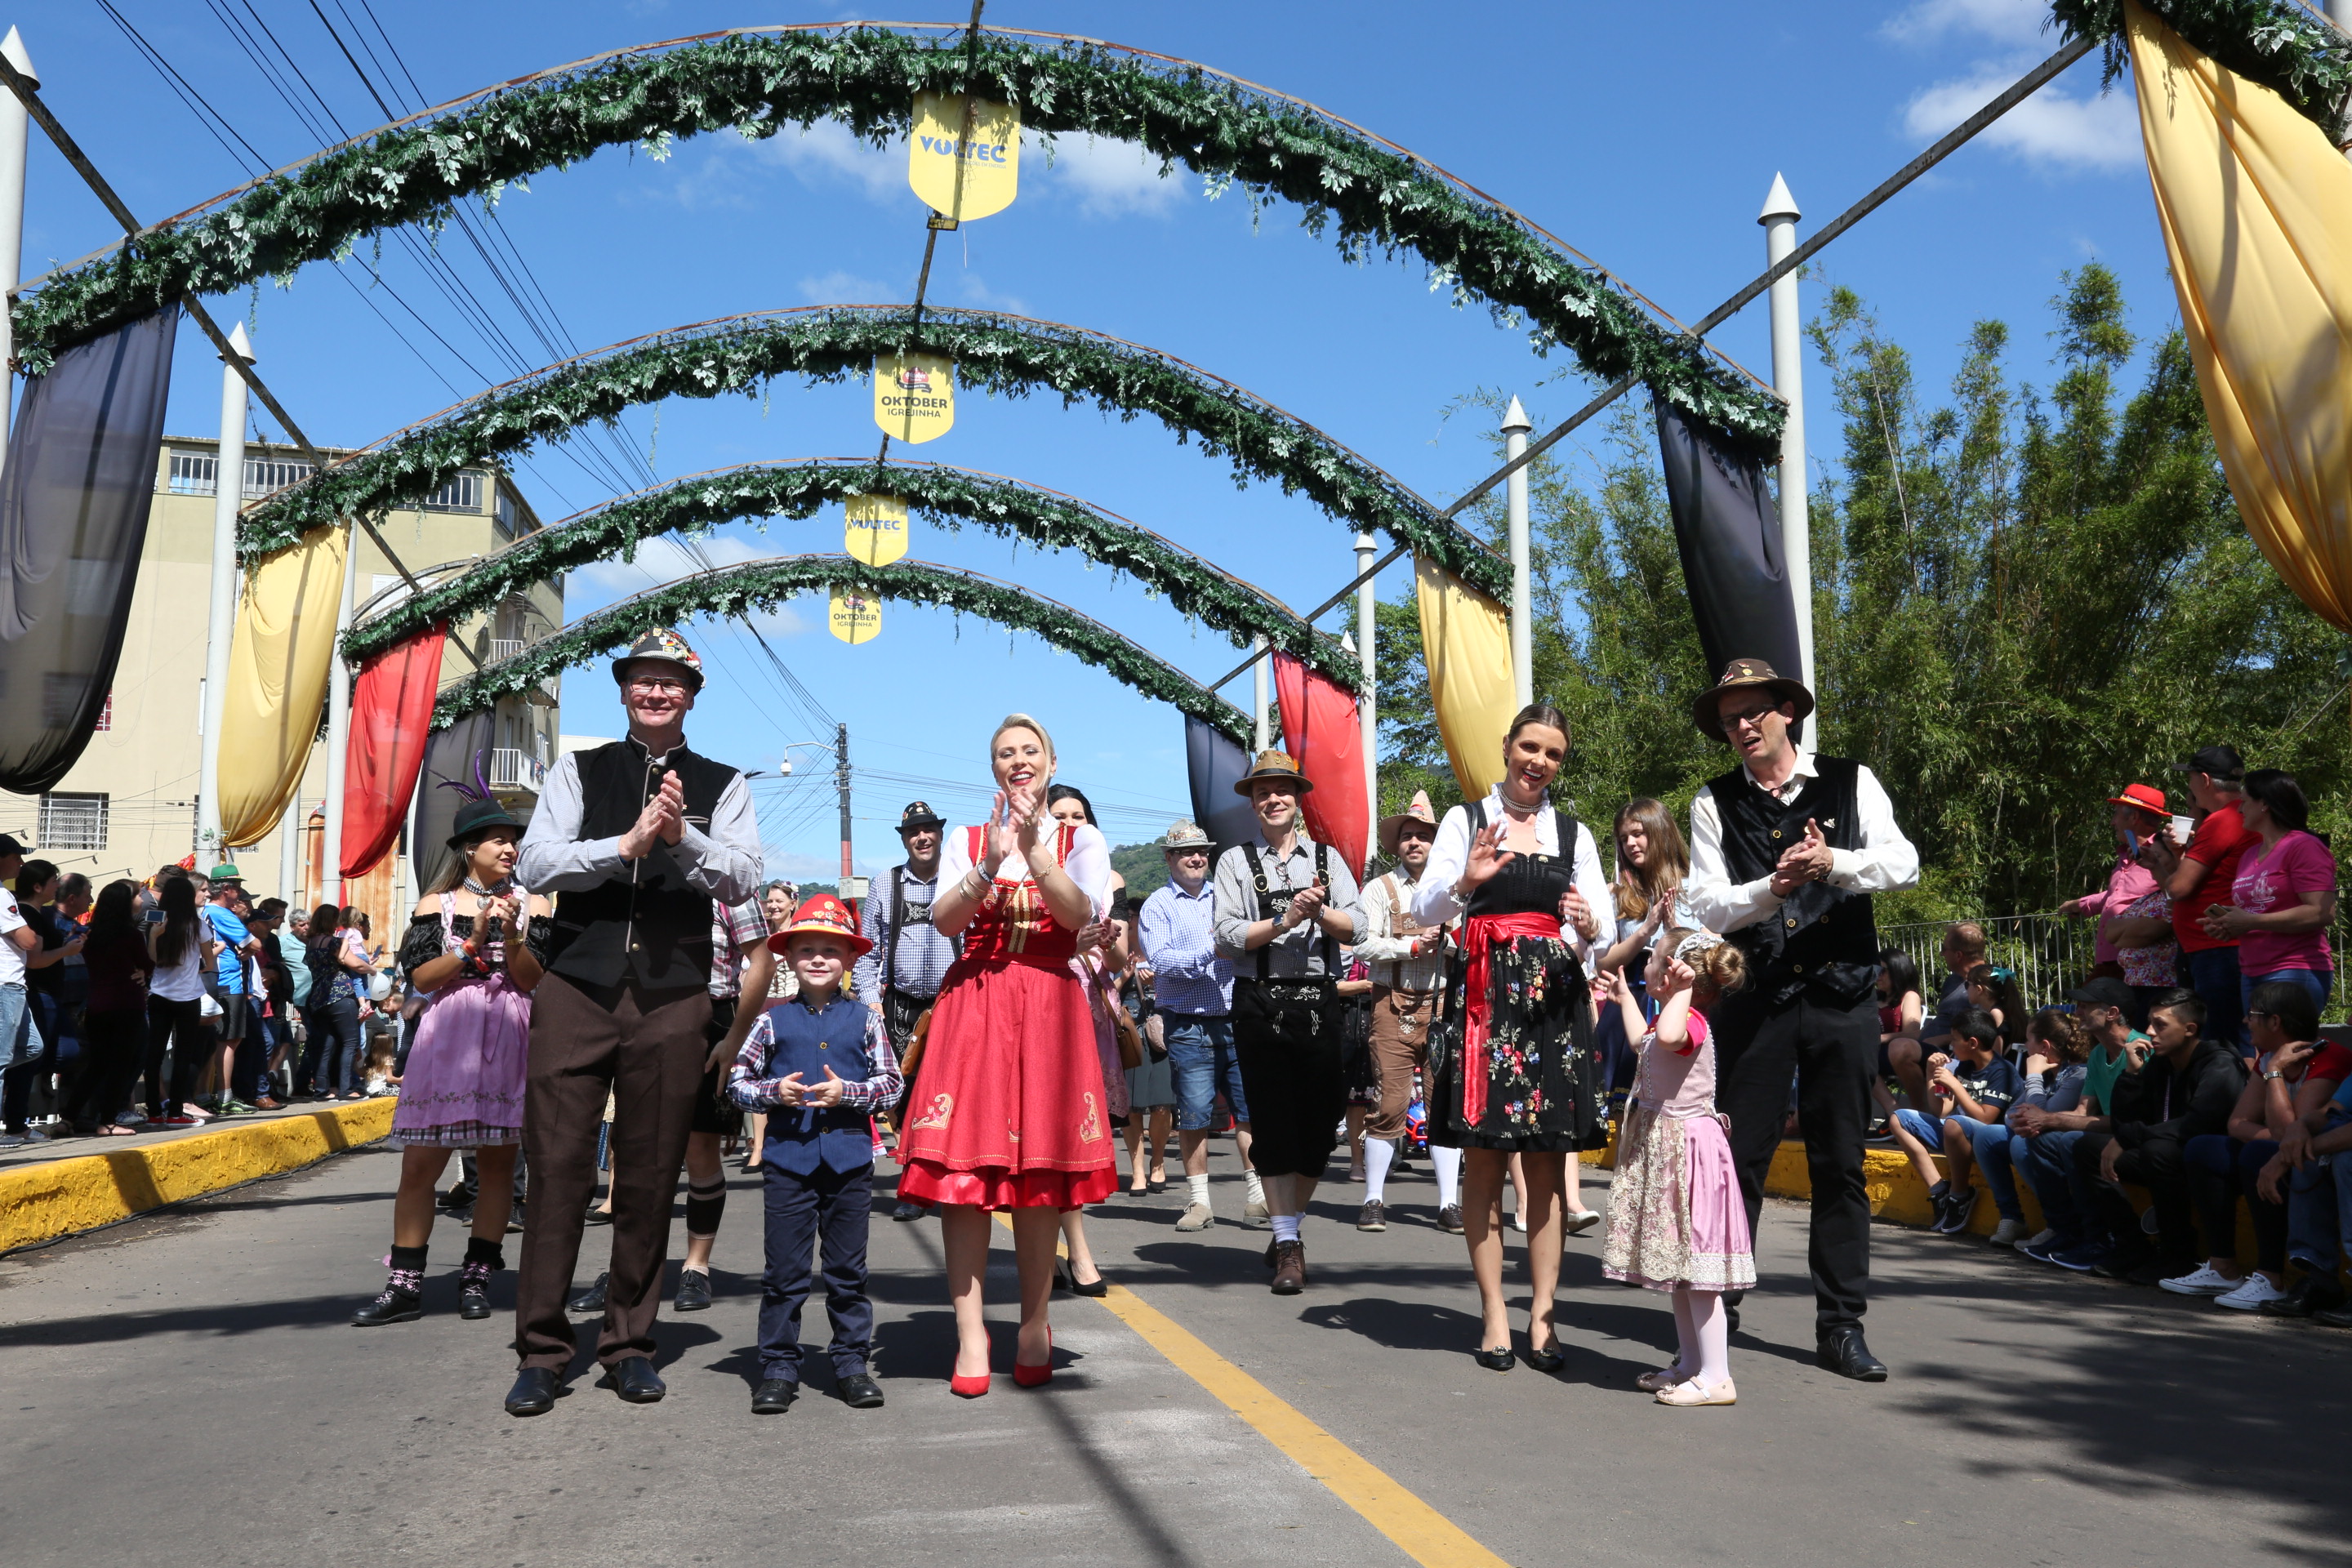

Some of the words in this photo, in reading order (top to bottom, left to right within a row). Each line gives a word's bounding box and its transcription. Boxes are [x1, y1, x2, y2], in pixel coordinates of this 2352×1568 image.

[920, 136, 1007, 163] VOLTEC
[881, 396, 947, 409] OKTOBER
[888, 408, 941, 418] IGREJINHA
